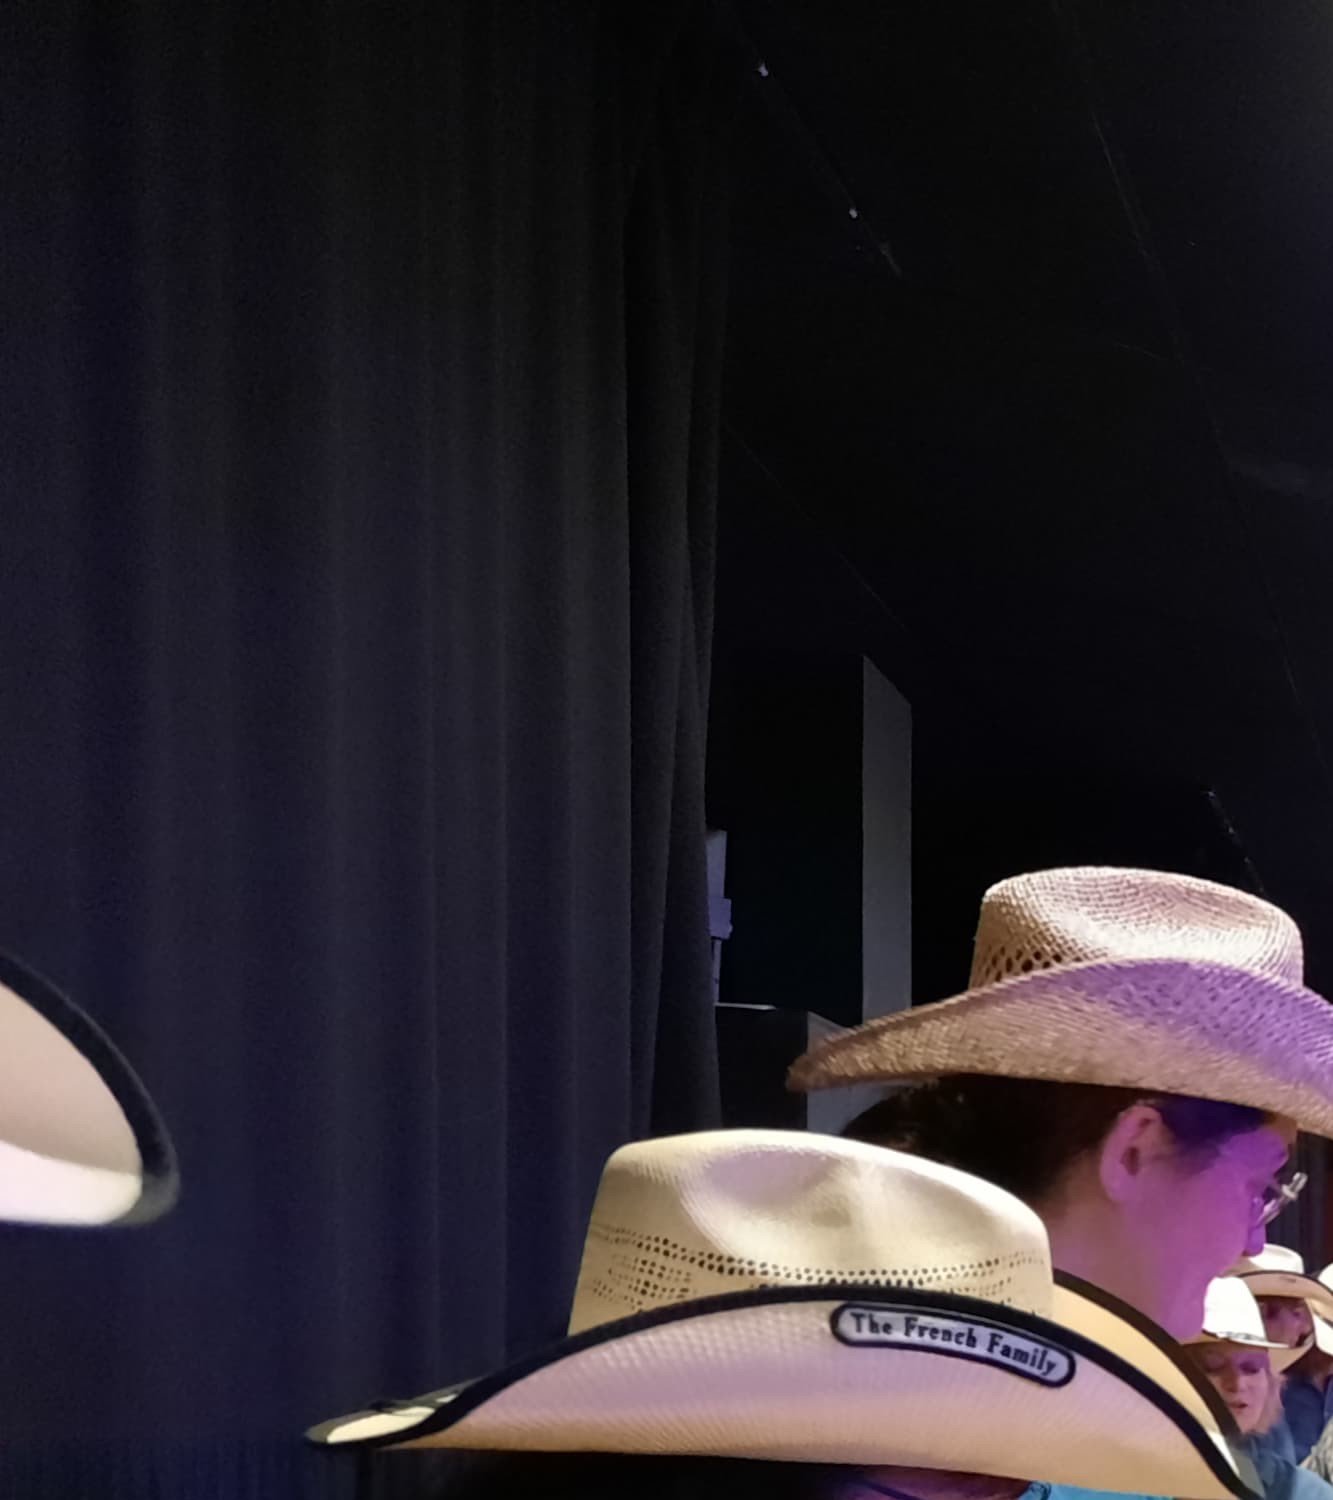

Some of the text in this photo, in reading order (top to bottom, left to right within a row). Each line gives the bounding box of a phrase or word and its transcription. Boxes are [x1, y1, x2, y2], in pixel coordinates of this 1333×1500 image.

[850, 1312, 1058, 1376] The French Family
